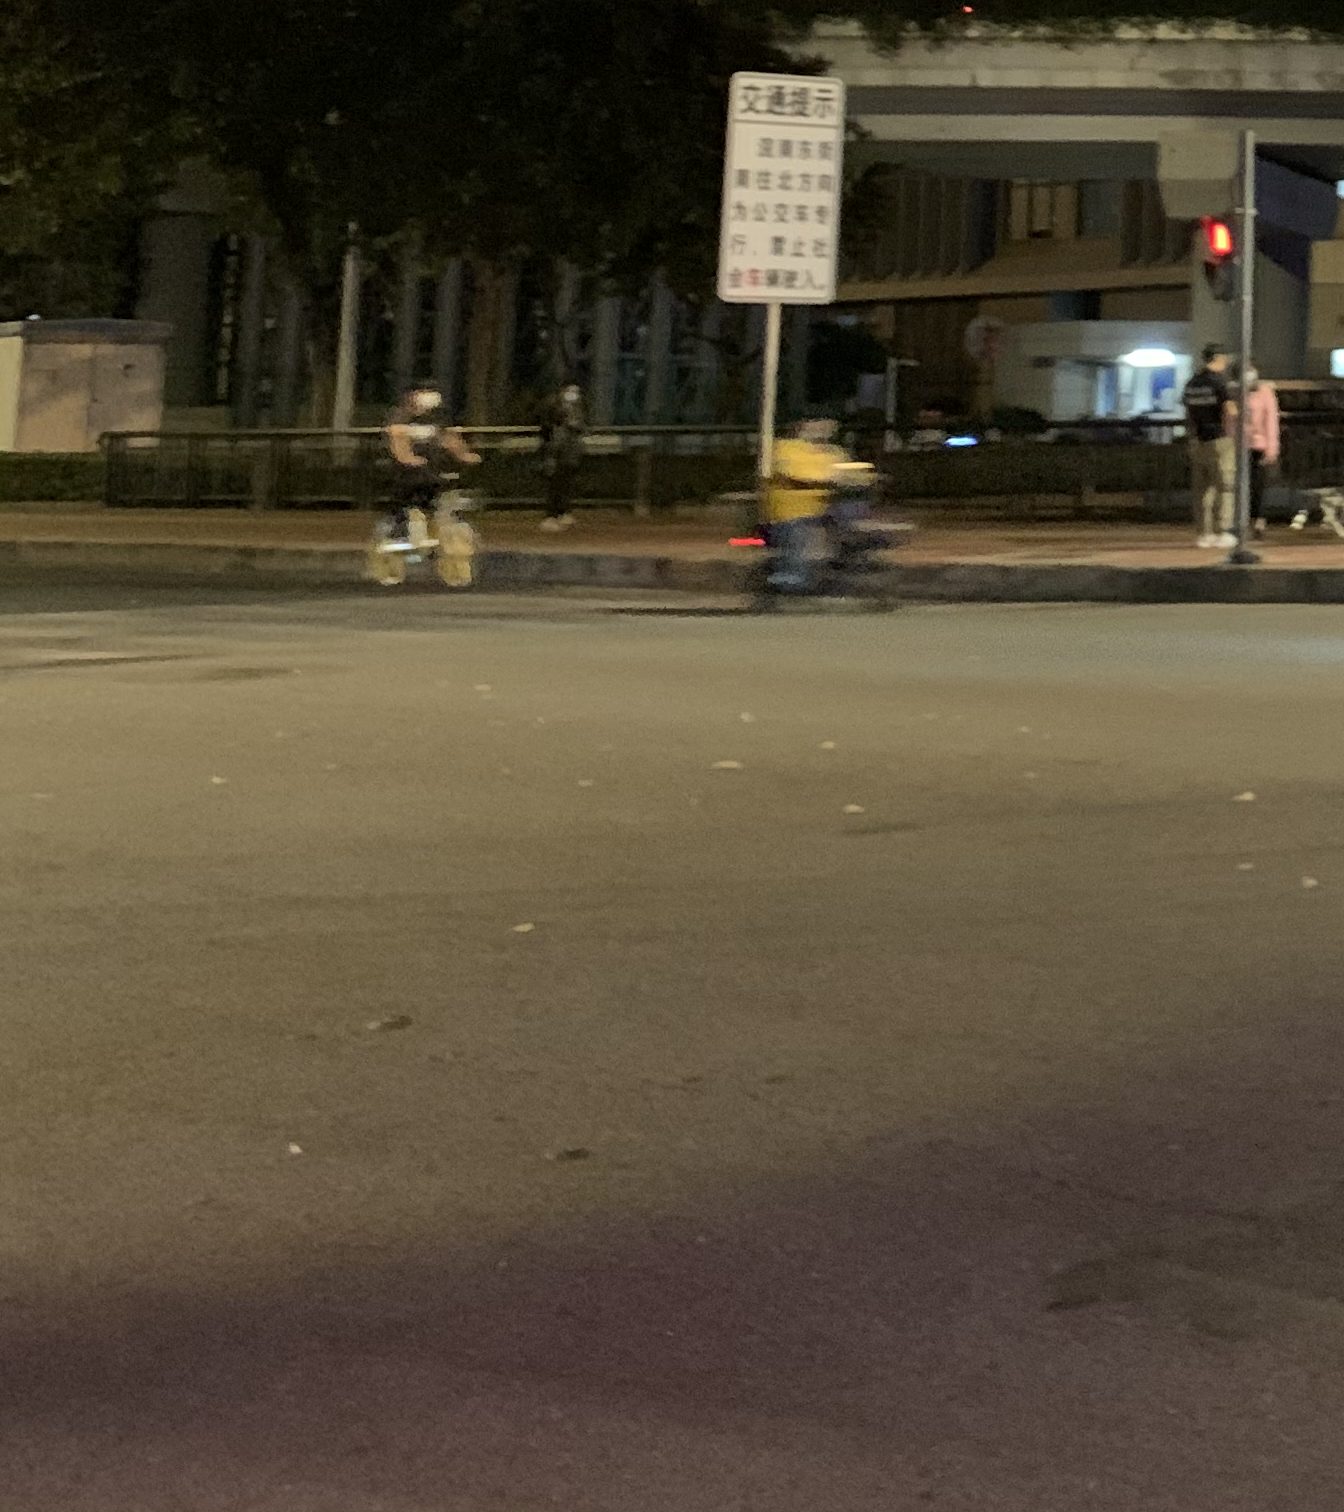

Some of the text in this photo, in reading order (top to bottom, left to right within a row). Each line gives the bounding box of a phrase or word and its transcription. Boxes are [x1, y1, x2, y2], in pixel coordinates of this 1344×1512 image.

[740, 85, 835, 119] 交通提示
[731, 201, 828, 225] 为公交车专
